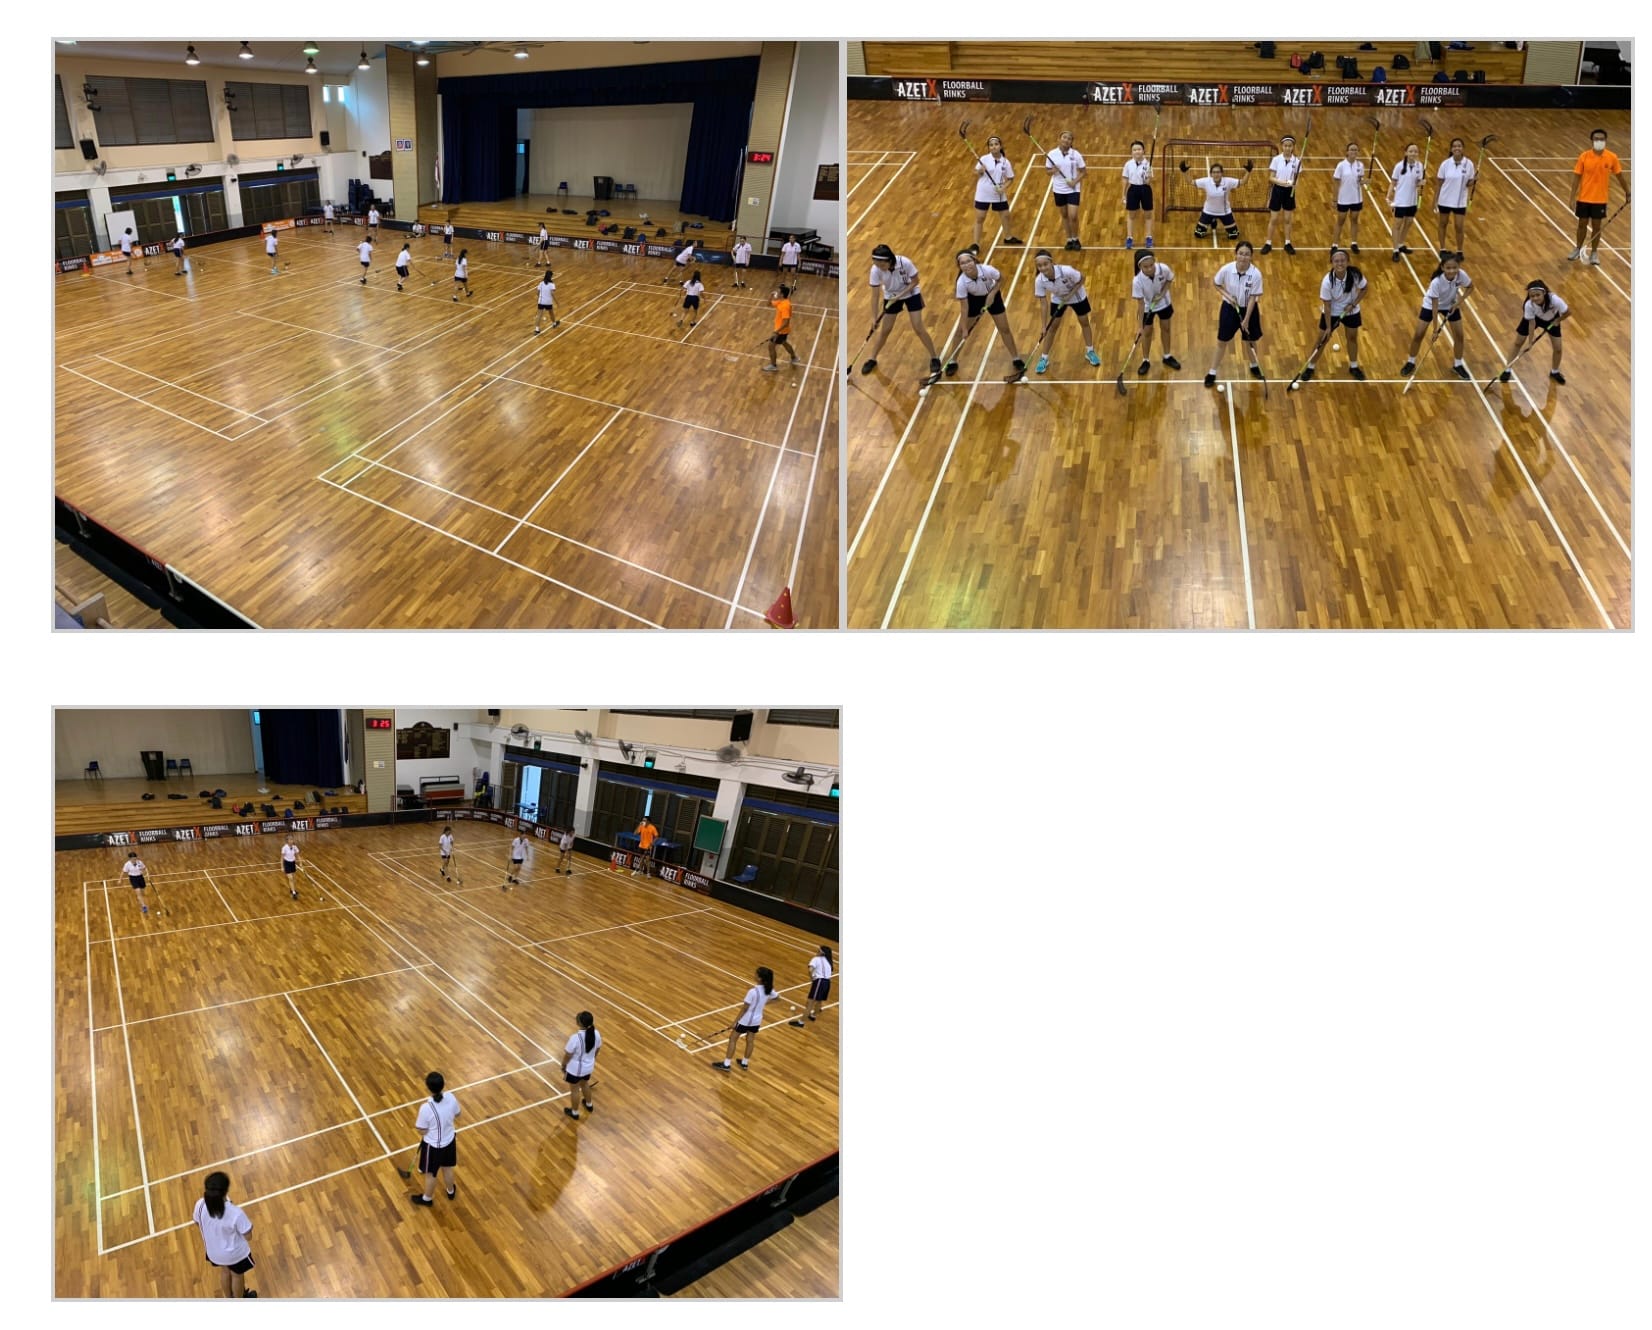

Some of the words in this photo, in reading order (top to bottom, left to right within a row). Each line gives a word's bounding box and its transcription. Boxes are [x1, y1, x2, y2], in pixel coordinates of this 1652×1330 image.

[897, 79, 938, 97] AZETX
[942, 81, 985, 89] FLOORBALL
[1138, 85, 1179, 93] FLOORBALL
[943, 90, 966, 98] RINKS
[1094, 82, 1133, 102] AZETX
[1190, 85, 1228, 103] AZETX
[1233, 86, 1273, 94] FLOORBALL
[1327, 87, 1366, 95] FLOORBALL
[1420, 87, 1460, 95] FLOORBALL
[1138, 93, 1161, 102] RINKS
[1283, 85, 1322, 104] AZETX
[1376, 85, 1415, 104] AZETX
[1234, 95, 1255, 103] RINKS
[1327, 95, 1349, 103] RINKS
[1420, 96, 1442, 104] RINKS
[623, 243, 645, 256] AZETX
